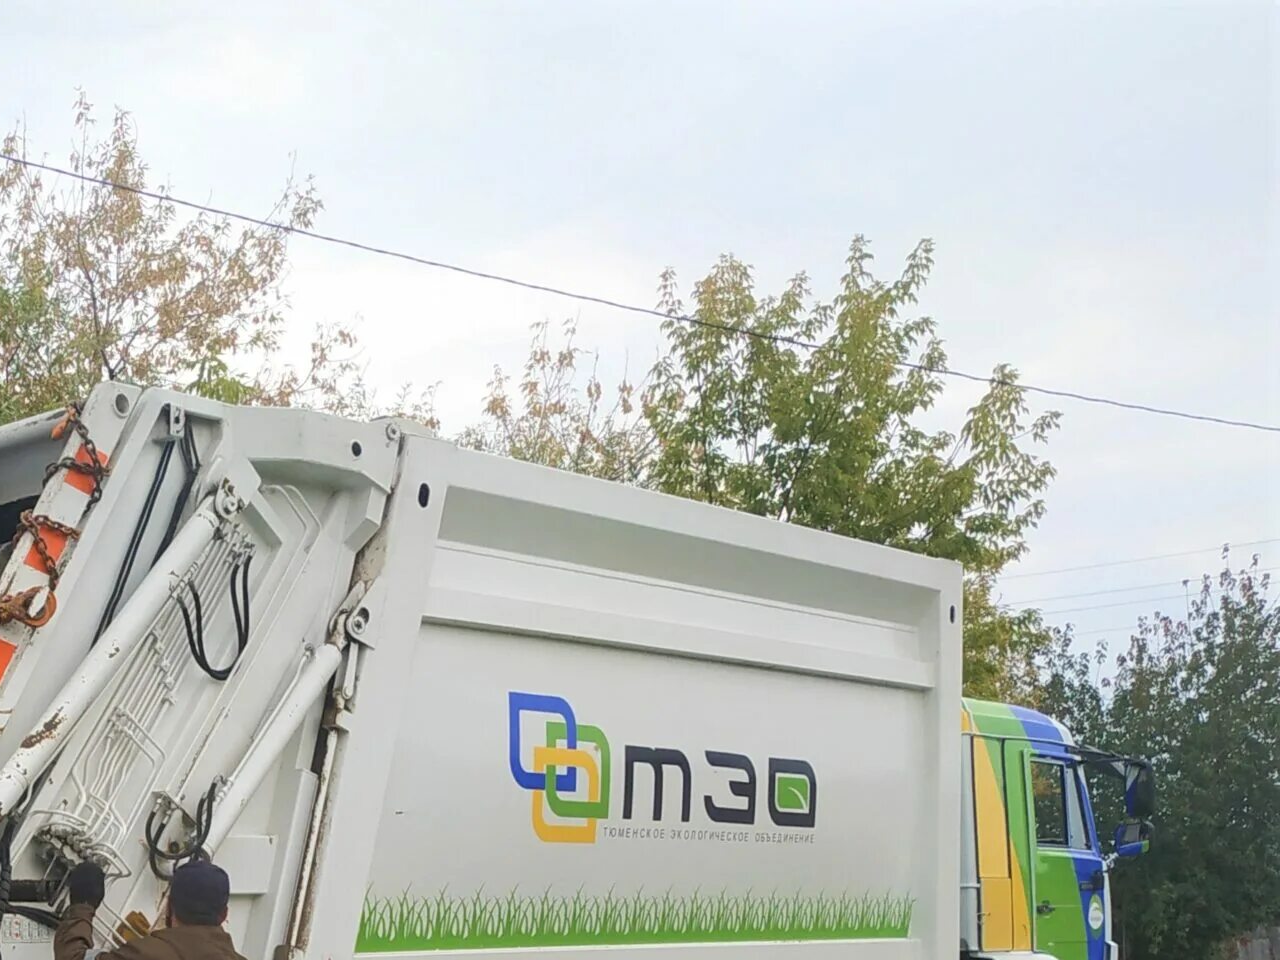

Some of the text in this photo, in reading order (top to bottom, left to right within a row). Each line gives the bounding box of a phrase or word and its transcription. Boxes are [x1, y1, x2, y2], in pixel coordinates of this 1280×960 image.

[603, 827, 816, 844] ТЮМЕНСКОЕ ЭКОЛОГИЧЕСКОЕ ОБЪЕДИНЕНИЕ
